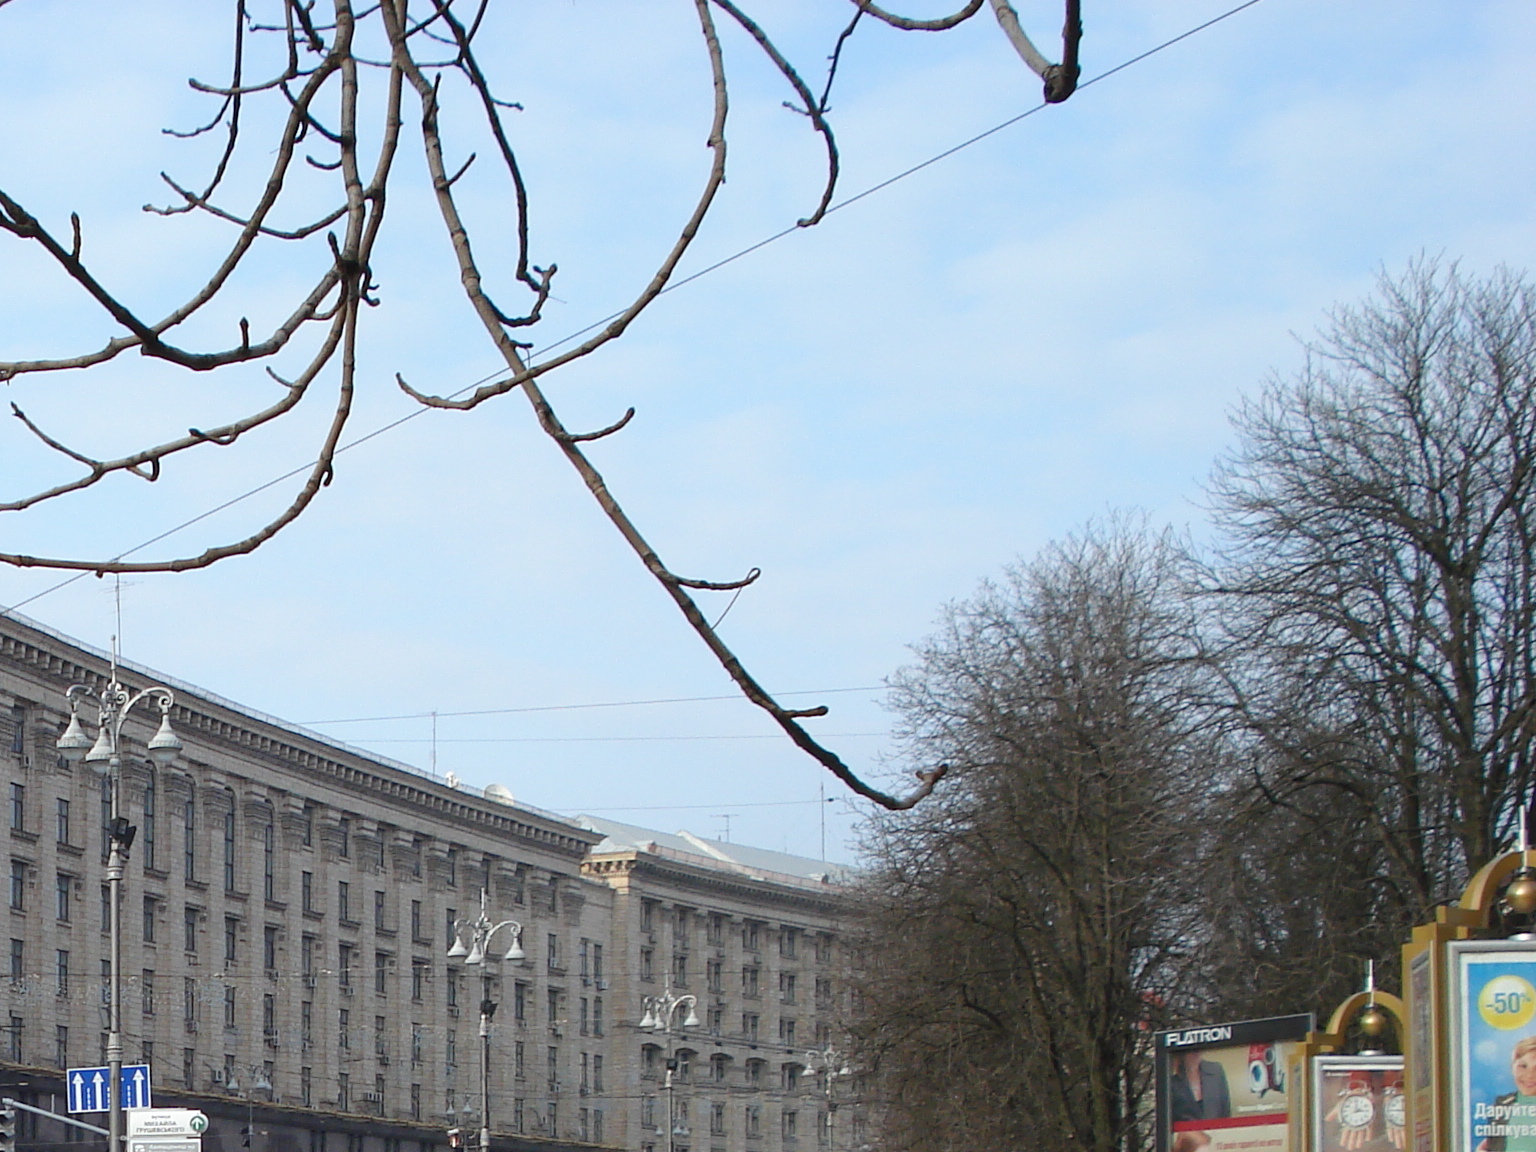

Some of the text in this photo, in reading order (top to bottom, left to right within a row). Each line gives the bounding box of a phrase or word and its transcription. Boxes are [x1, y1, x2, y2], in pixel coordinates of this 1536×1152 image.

[1485, 991, 1532, 1014] -50%
[1165, 1026, 1232, 1047] FLATRON
[1474, 1102, 1536, 1120] Даруйте
